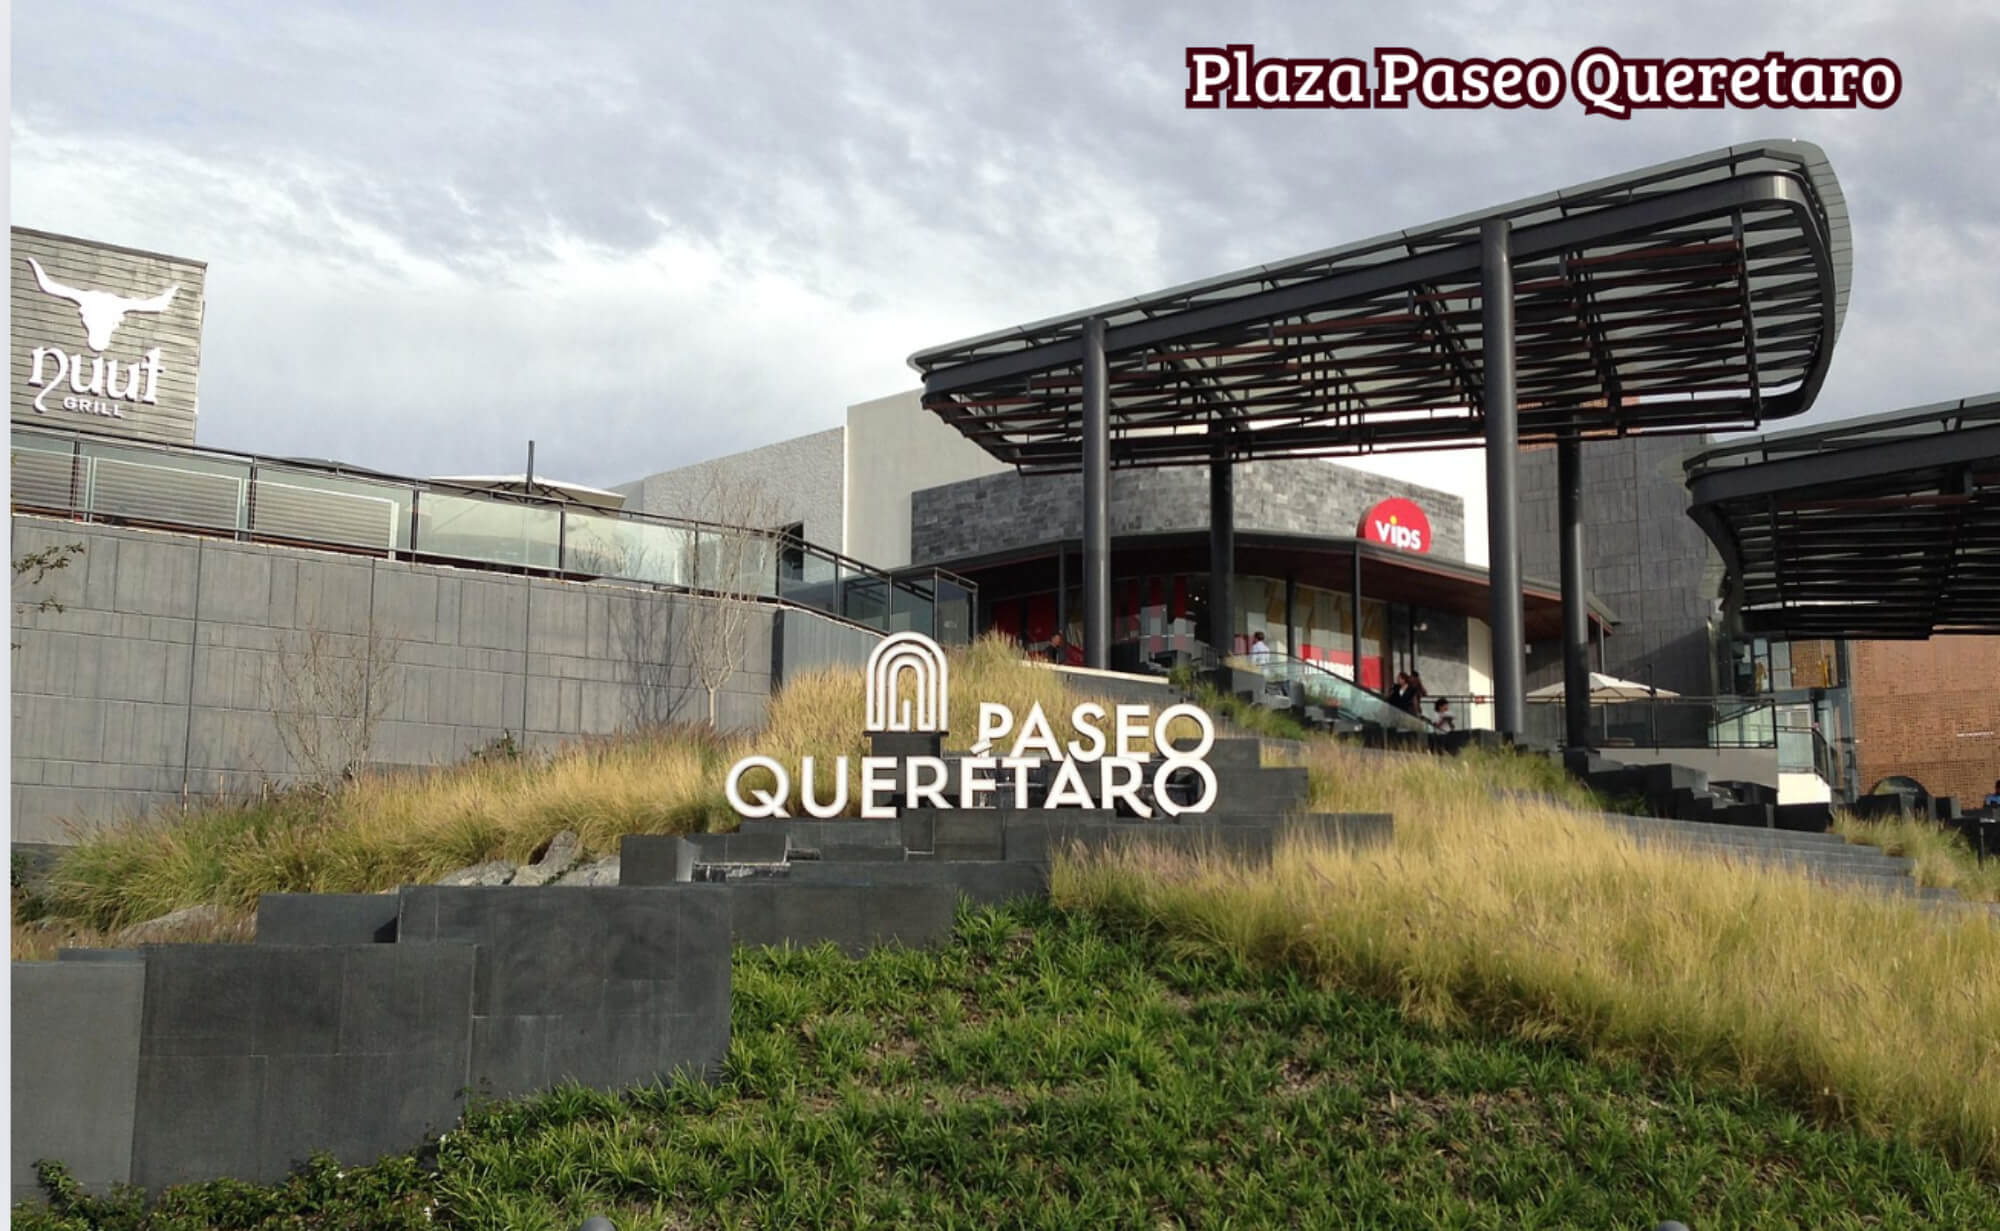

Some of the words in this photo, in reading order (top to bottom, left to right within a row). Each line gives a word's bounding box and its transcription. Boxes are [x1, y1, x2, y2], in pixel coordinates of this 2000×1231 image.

[62, 395, 123, 418] GRILL
[976, 700, 1216, 763] PASEO
[724, 740, 1219, 818] QUERÉTARO
